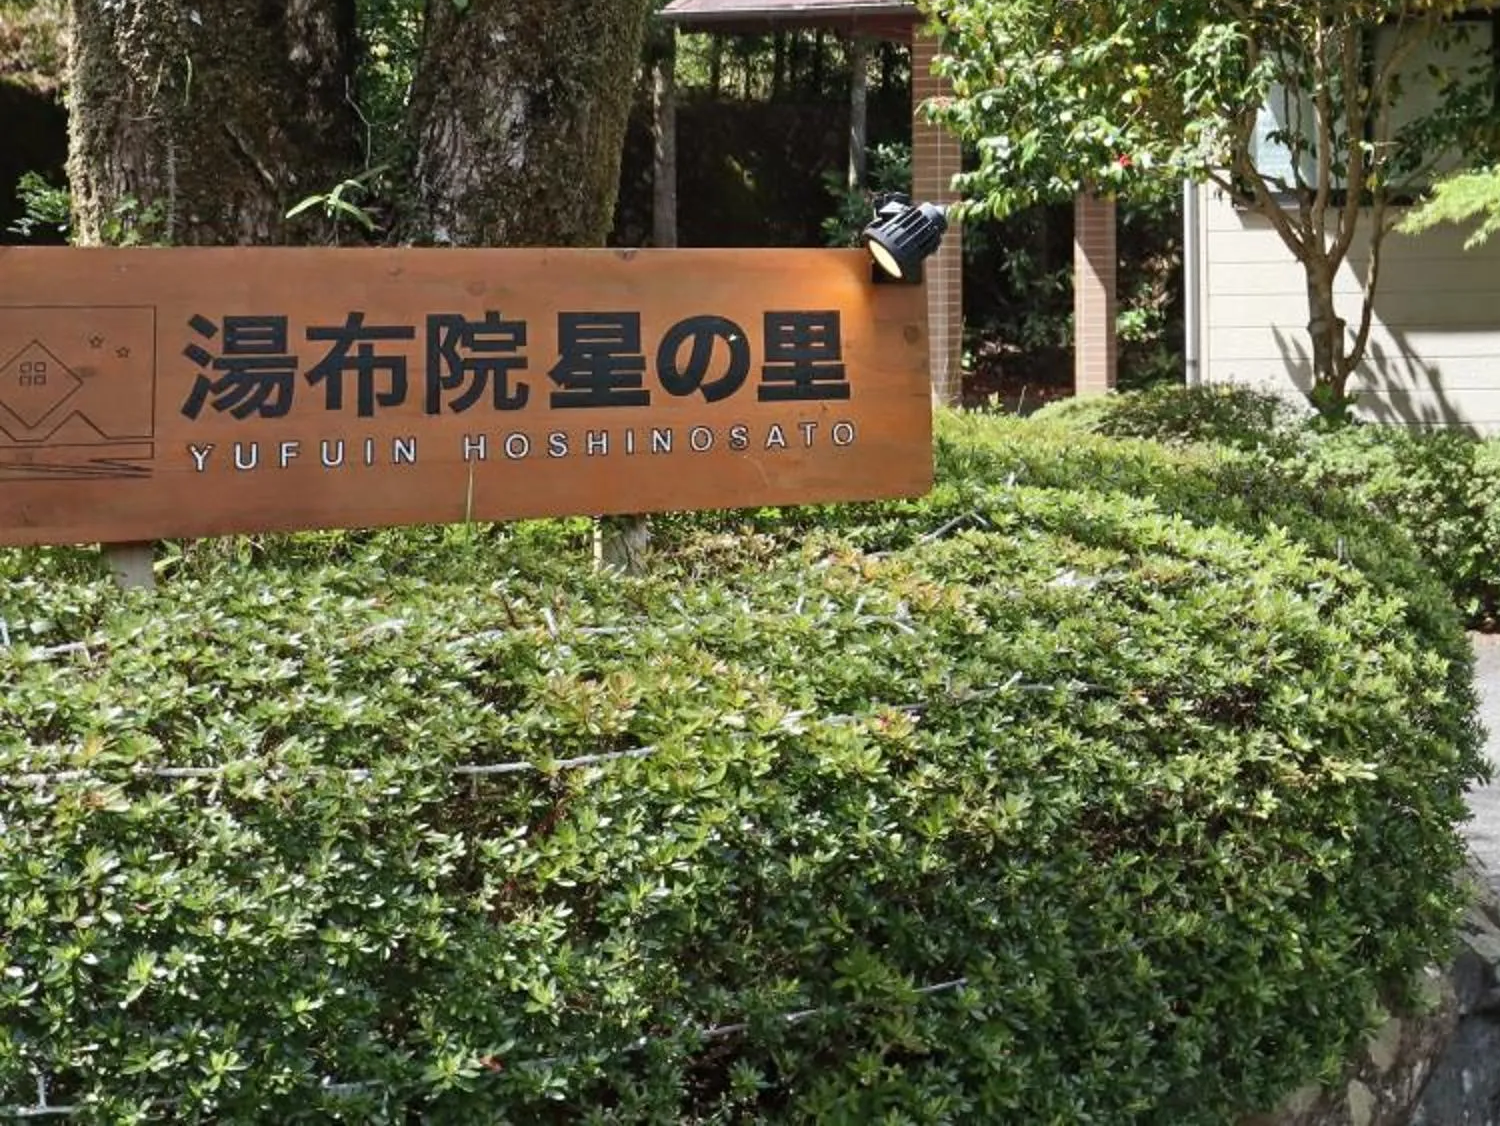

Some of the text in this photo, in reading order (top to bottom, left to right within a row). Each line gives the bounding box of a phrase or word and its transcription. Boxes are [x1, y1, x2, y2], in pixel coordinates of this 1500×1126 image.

[181, 310, 851, 421] 湯布院星の里
[188, 421, 856, 472] YUFUIN HOSHINOSATO
